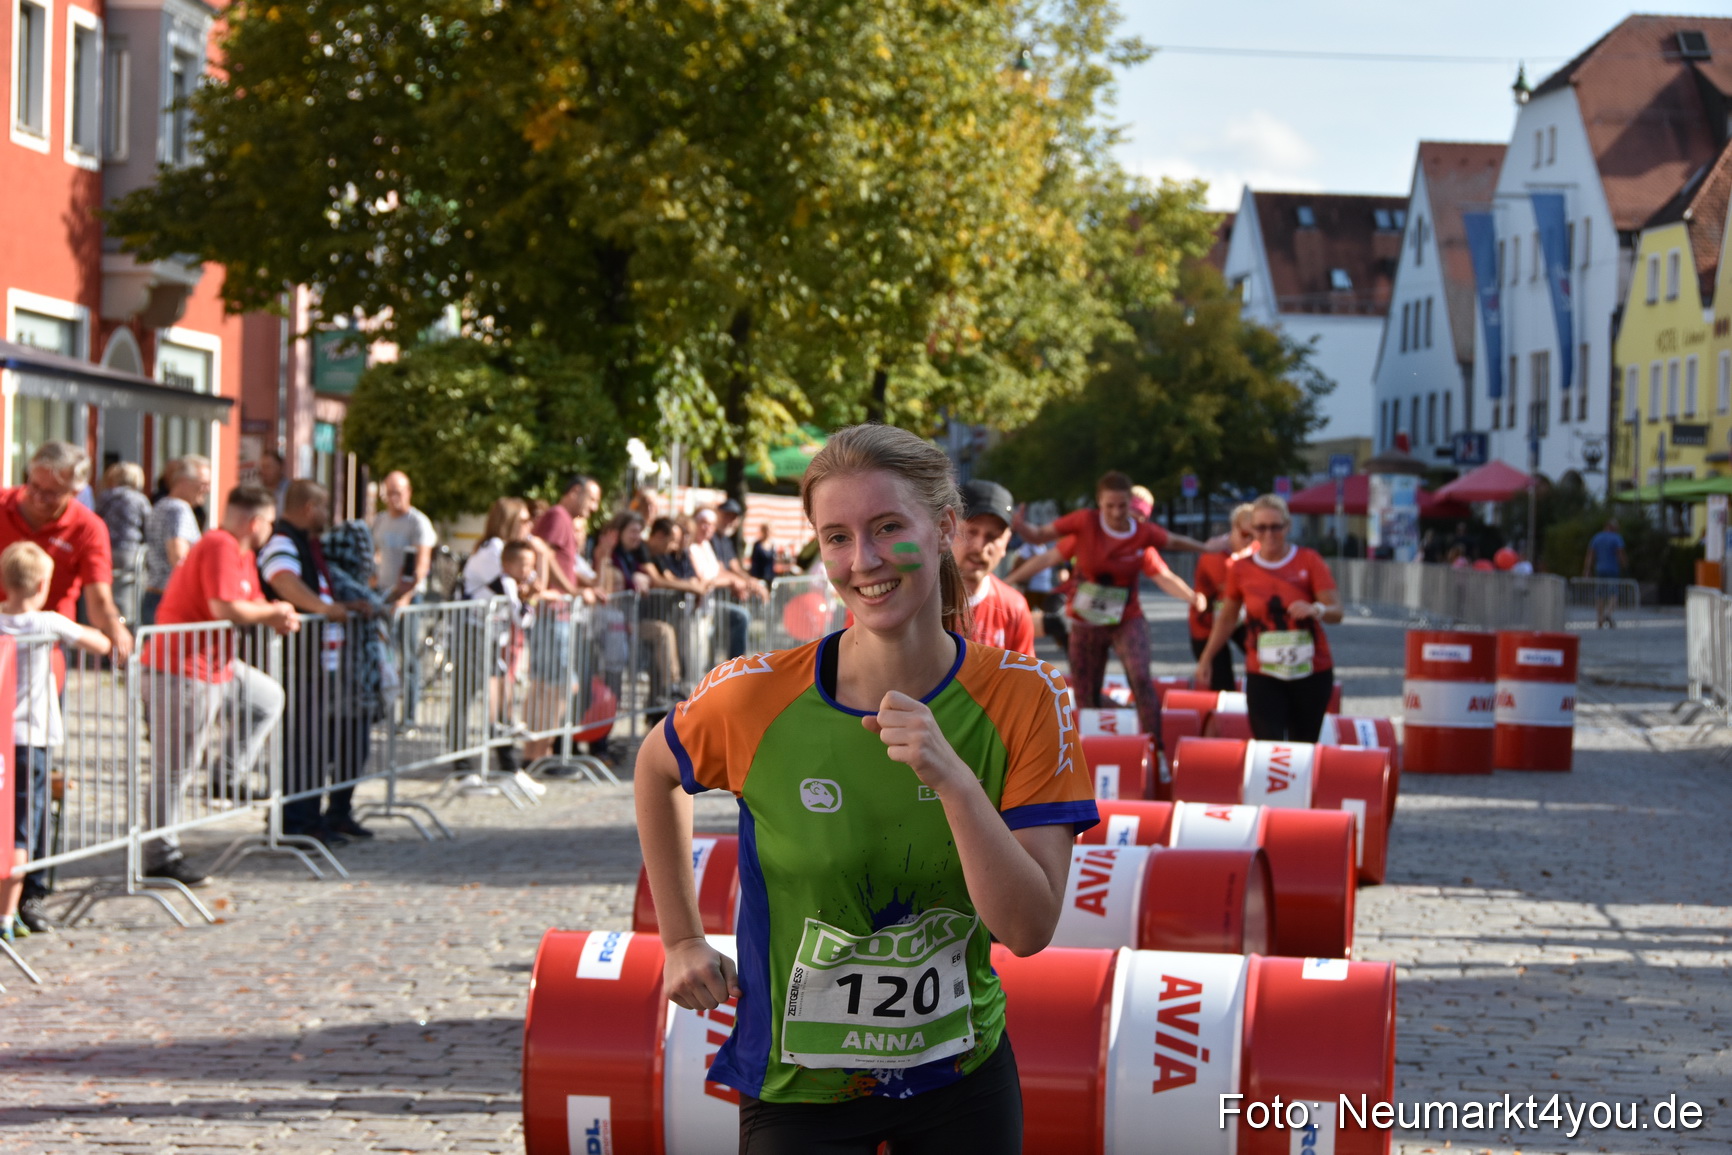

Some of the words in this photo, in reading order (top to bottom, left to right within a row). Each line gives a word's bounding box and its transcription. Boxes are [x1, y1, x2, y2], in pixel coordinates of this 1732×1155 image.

[679, 652, 776, 717] OCK
[811, 913, 959, 964] BOCK
[951, 952, 962, 964] E6
[836, 966, 941, 1018] 120
[841, 1030, 926, 1052] ANNA
